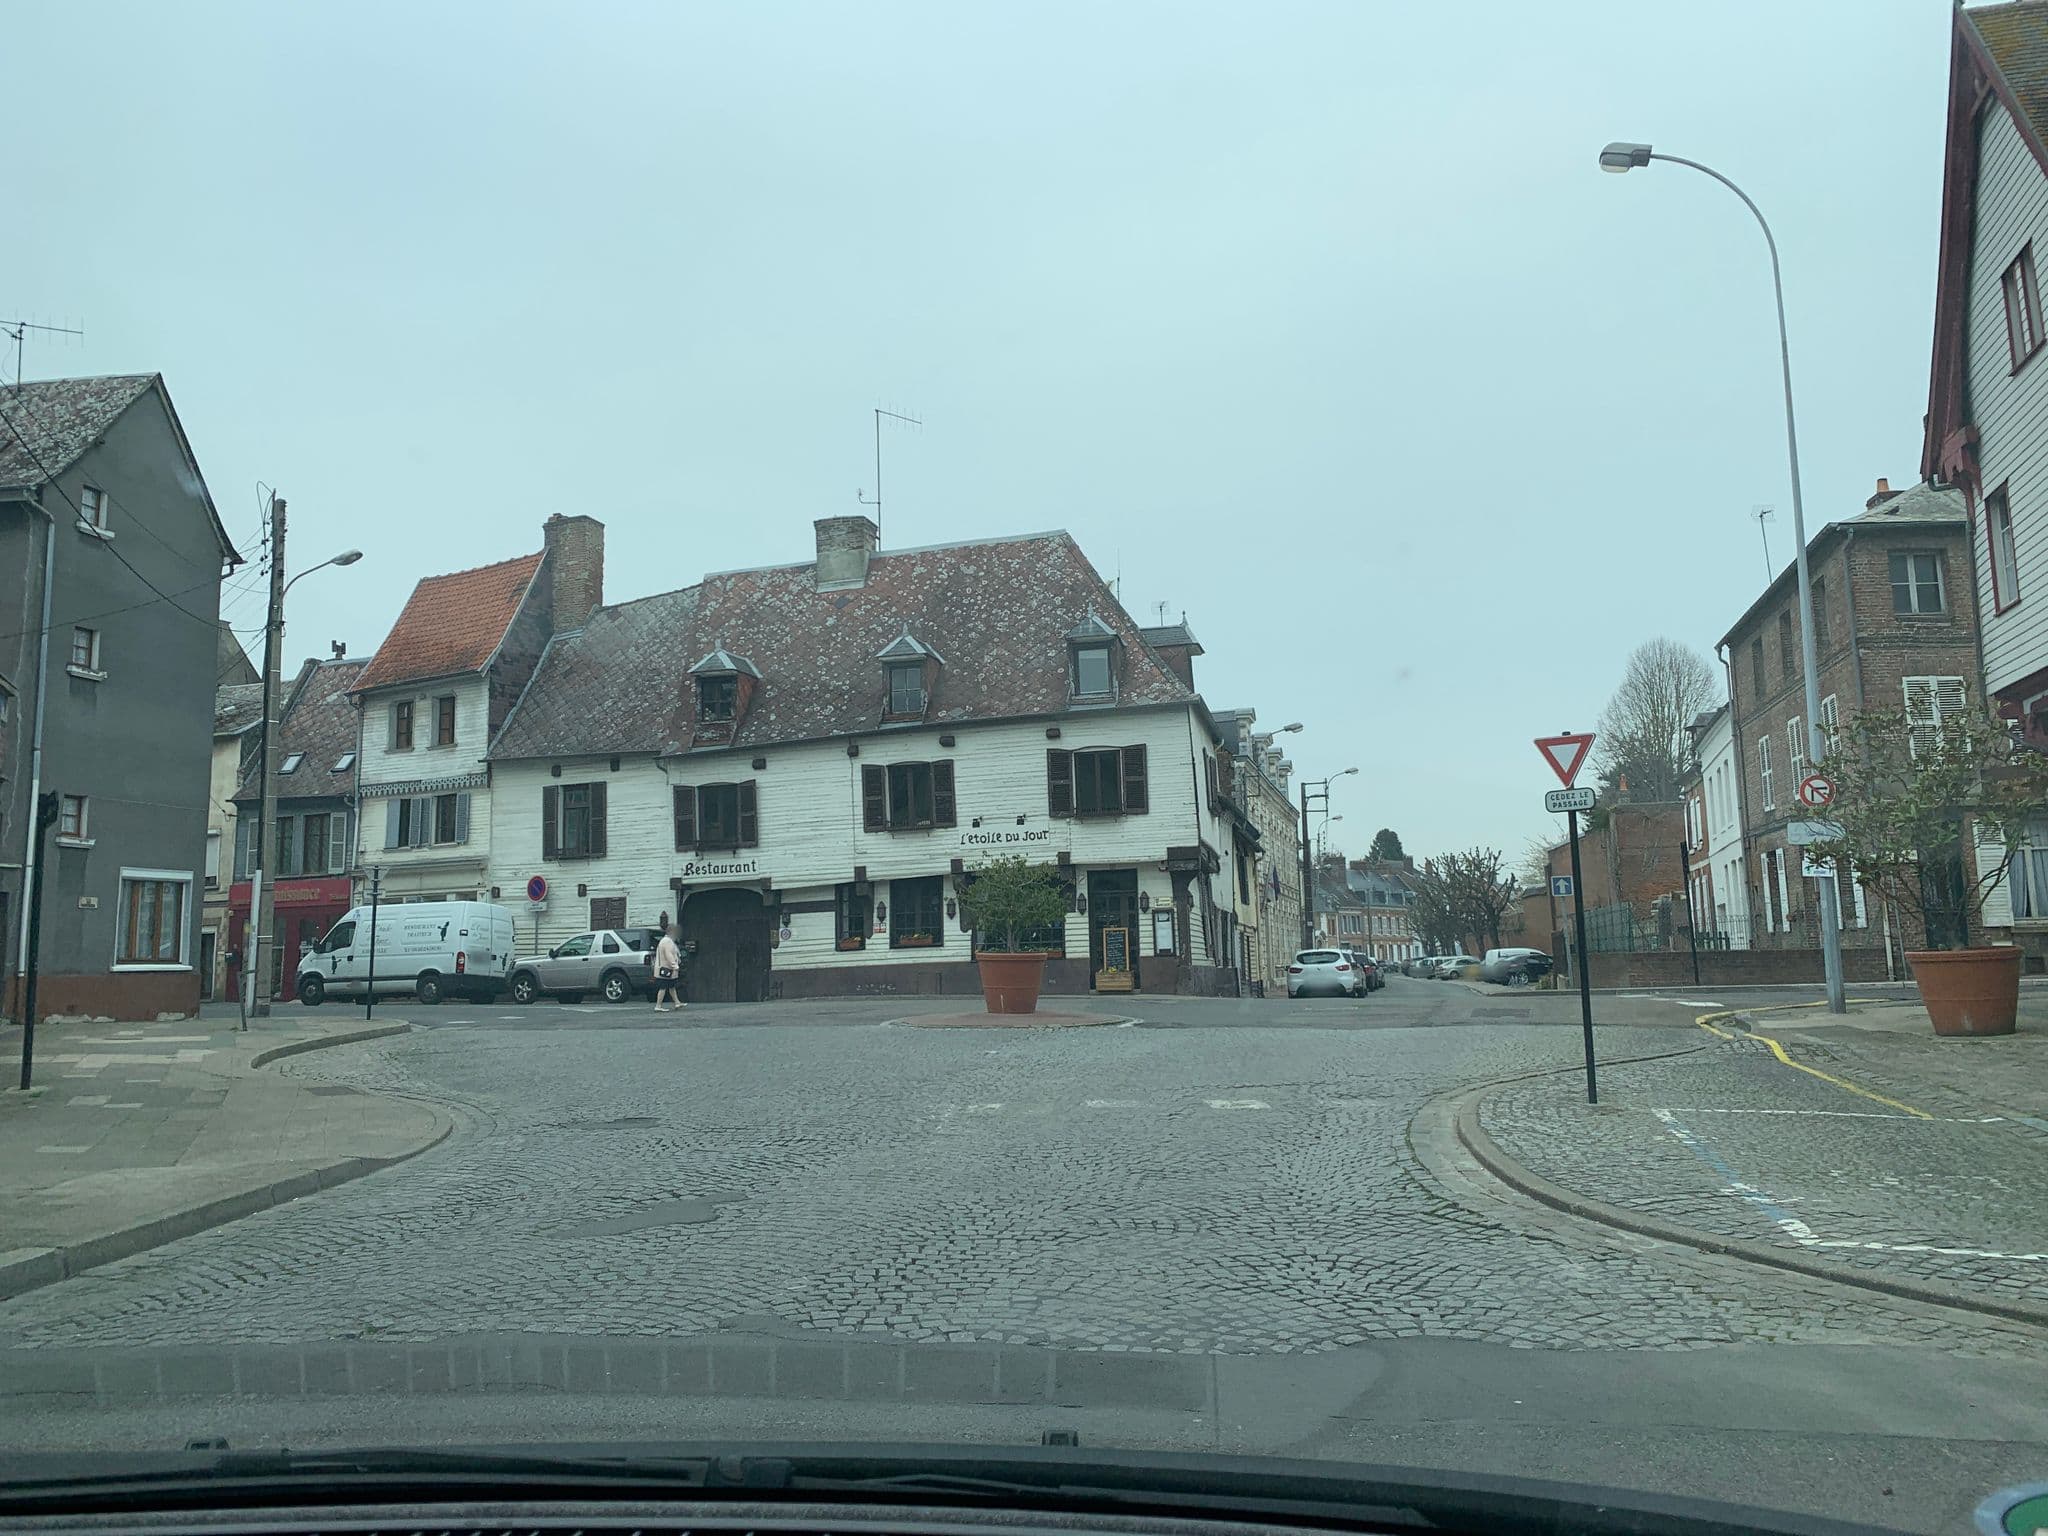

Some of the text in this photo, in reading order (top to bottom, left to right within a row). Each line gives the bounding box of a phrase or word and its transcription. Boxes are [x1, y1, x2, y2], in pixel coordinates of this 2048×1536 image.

[1580, 791, 1589, 799] LE
[1552, 799, 1589, 808] PASSAGE
[683, 858, 757, 876] Restaurant
